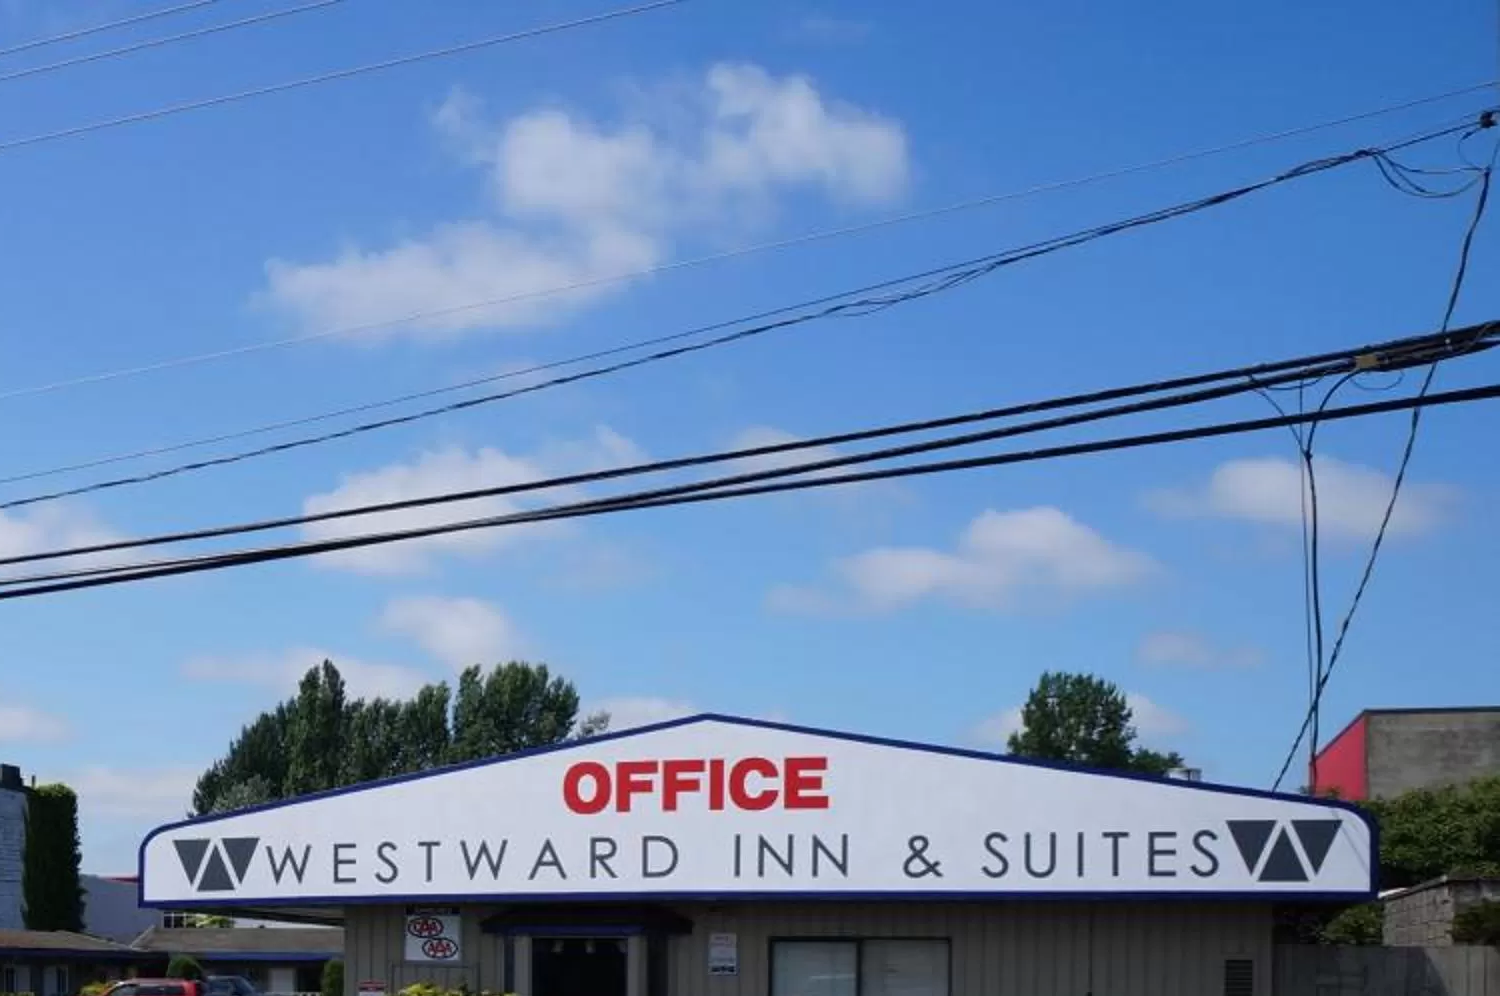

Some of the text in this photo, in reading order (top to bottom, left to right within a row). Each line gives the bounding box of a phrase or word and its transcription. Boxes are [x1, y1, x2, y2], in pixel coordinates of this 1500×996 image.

[564, 756, 829, 814] OFFICE
[266, 830, 1220, 884] WESTWARD INN & SUITES
